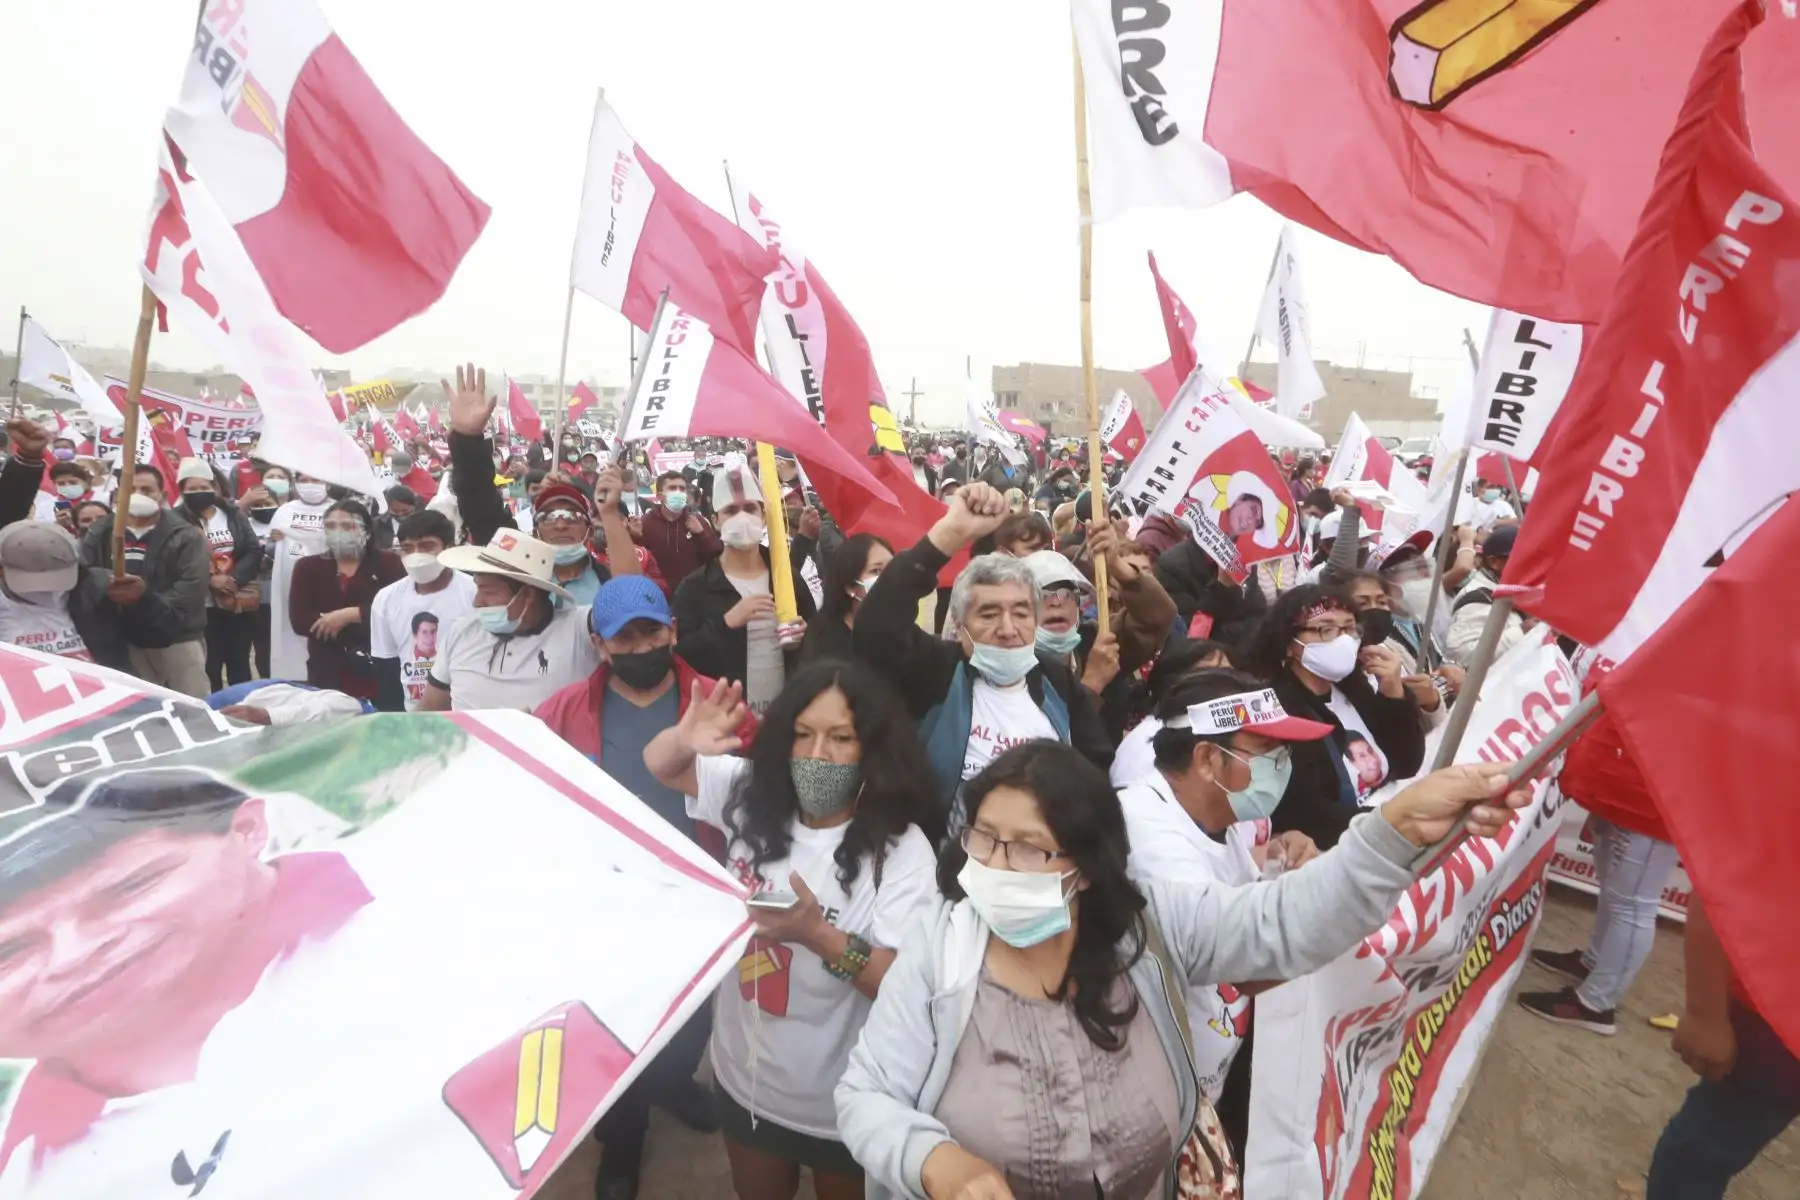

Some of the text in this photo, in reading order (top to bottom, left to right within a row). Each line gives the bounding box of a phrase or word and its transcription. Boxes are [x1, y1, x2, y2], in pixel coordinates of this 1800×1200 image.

[600, 150, 632, 267] PERU LIBRE
[640, 347, 678, 430] LIBRE
[1484, 319, 1552, 447] LIBRE
[1569, 190, 1784, 551] PERU LIBRE
[184, 411, 264, 430] PERU
[1139, 440, 1187, 505] LIBRE
[15, 632, 57, 646] PERU
[1214, 717, 1236, 728] LIBRE
